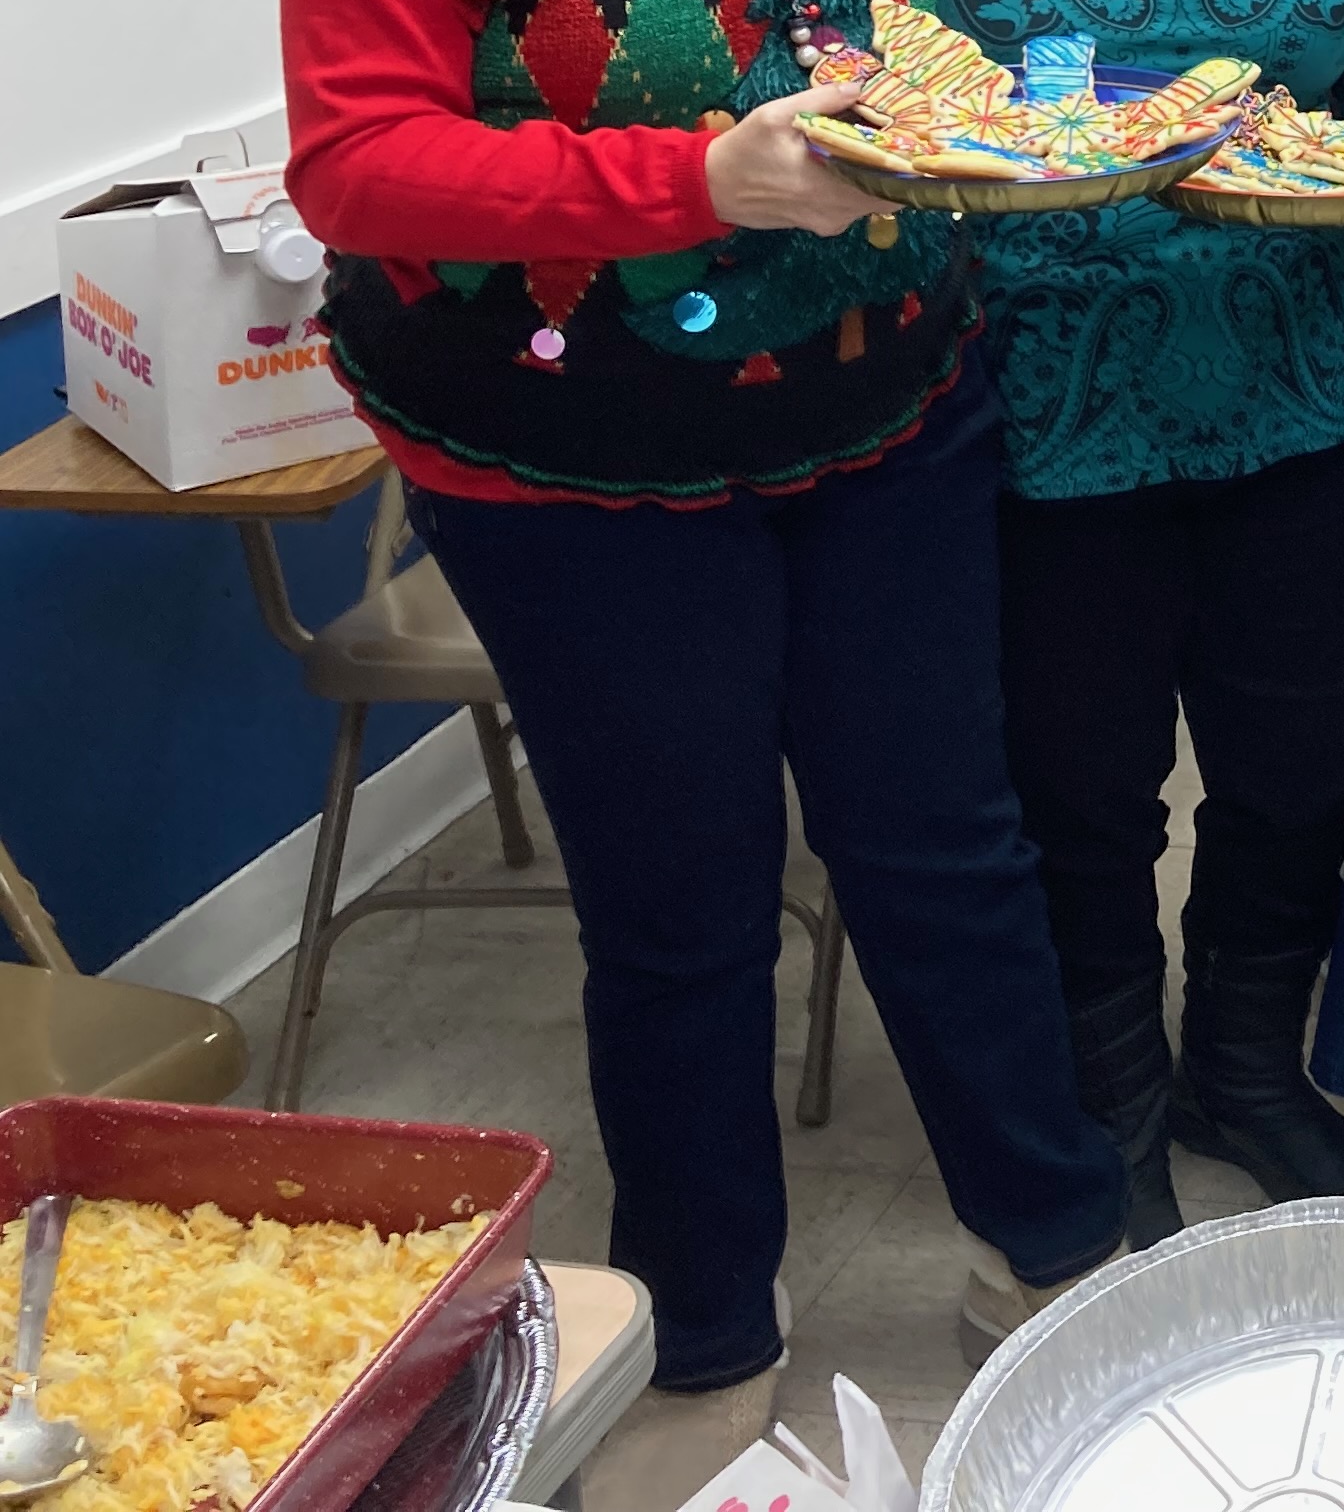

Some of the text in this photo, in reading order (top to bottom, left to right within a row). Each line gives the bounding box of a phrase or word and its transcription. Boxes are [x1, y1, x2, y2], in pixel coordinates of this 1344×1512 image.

[68, 297, 97, 347] BOX
[117, 340, 153, 388] JOE
[217, 343, 330, 386] DUNKI
